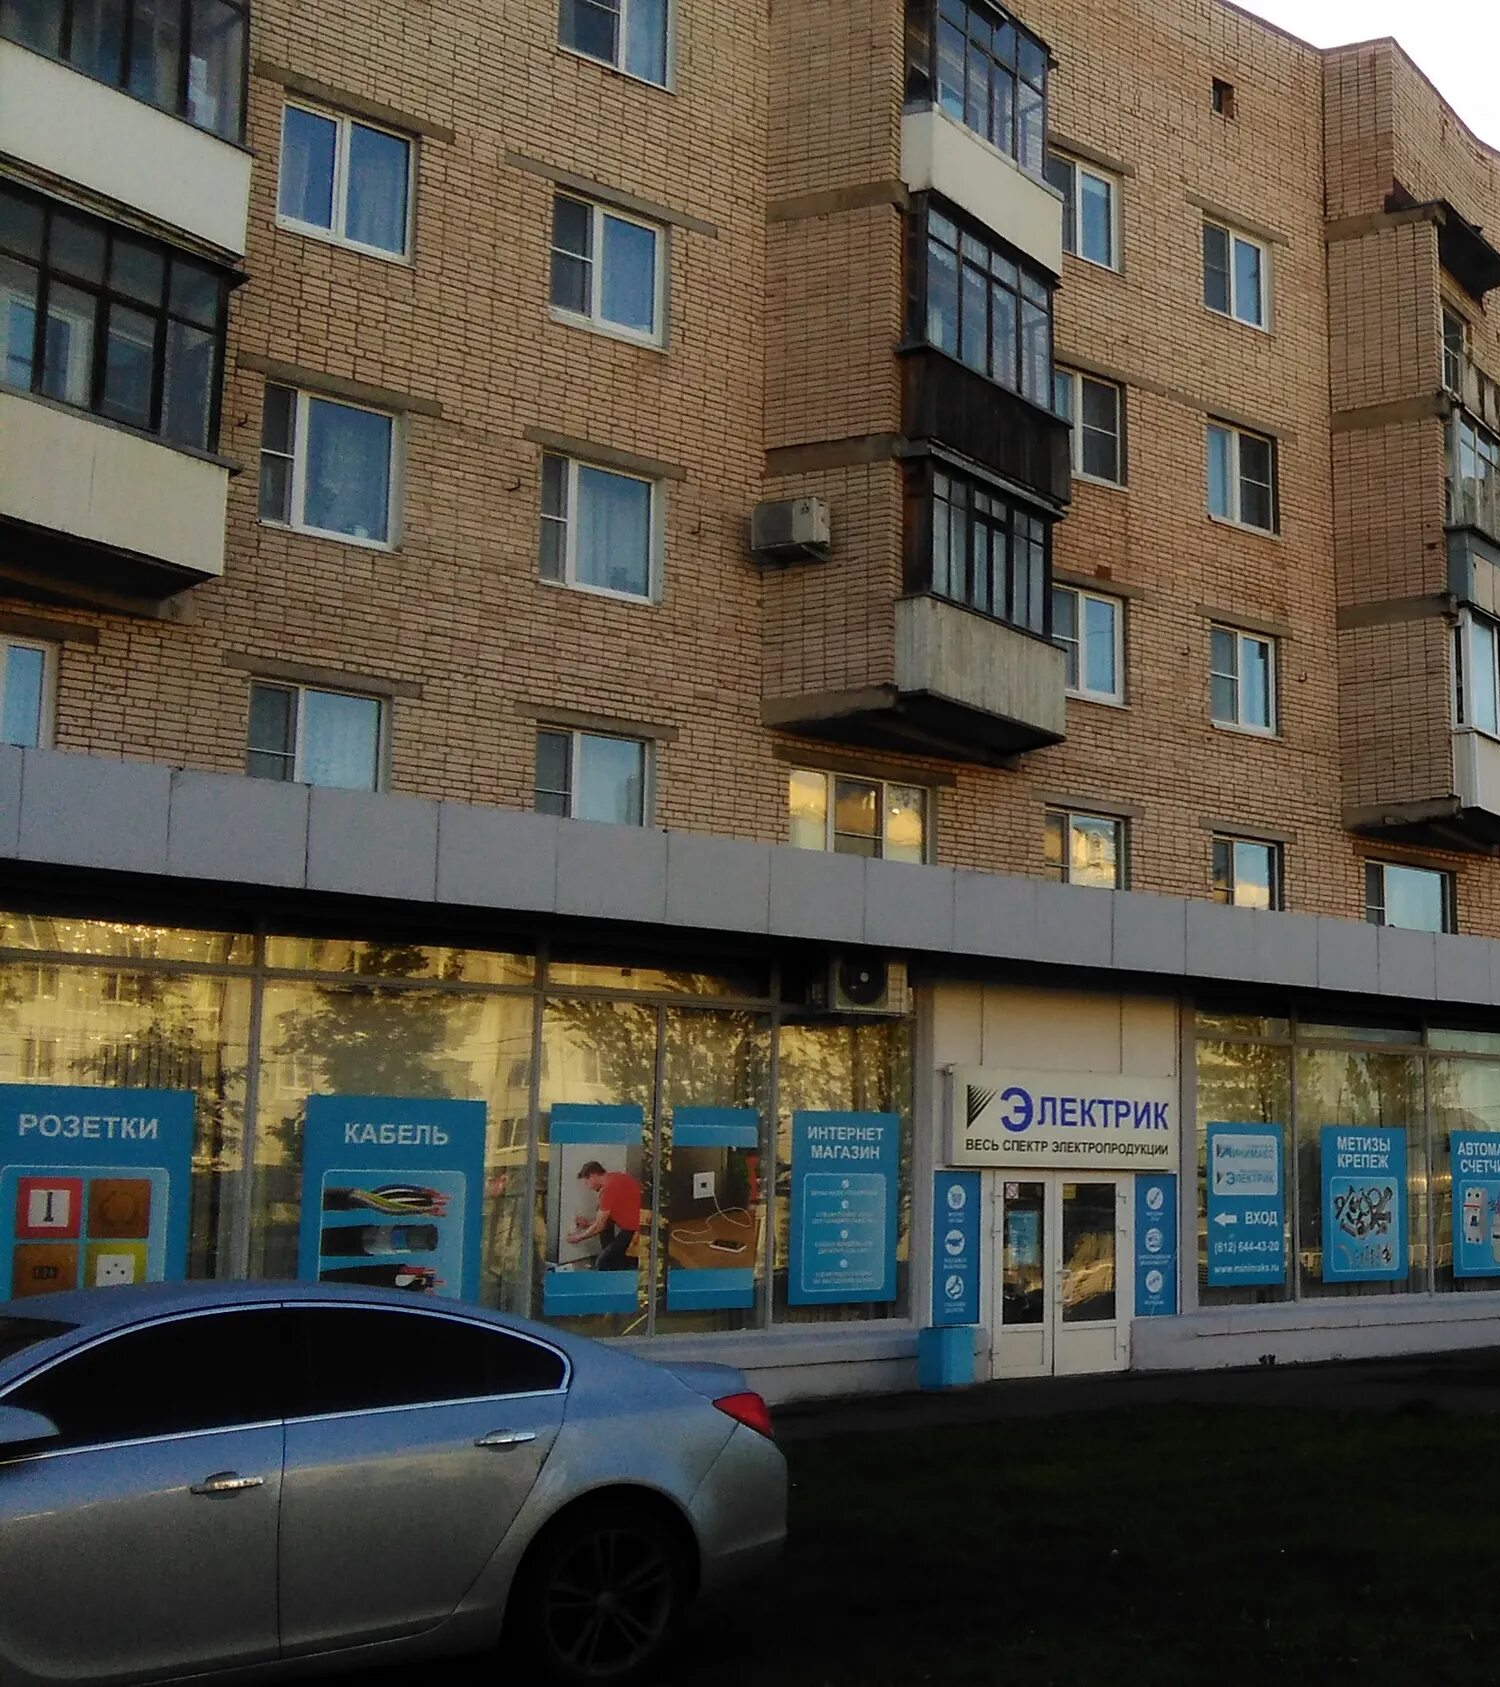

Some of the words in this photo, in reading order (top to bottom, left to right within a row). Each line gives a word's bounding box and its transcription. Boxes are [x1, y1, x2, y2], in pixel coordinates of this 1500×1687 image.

[1000, 1087, 1169, 1132] ЭЛЕКТРИК
[18, 1114, 158, 1139] РОЗЕТКИ
[344, 1122, 449, 1146] КАБЕЛЬ
[808, 1126, 884, 1141] ИНТЕРНЕТ
[966, 1138, 999, 1152] ВЕСЬ
[1003, 1139, 1048, 1153] СПЕКТР
[1052, 1140, 1168, 1156] ЭЛЕКТРОПРОДУКЦИИ
[1337, 1136, 1391, 1152] МЕТИЗЫ
[811, 1145, 881, 1160] МАГАЗИН
[1337, 1153, 1389, 1168] КРЕПЕЖ
[1245, 1211, 1278, 1226] ВХОД
